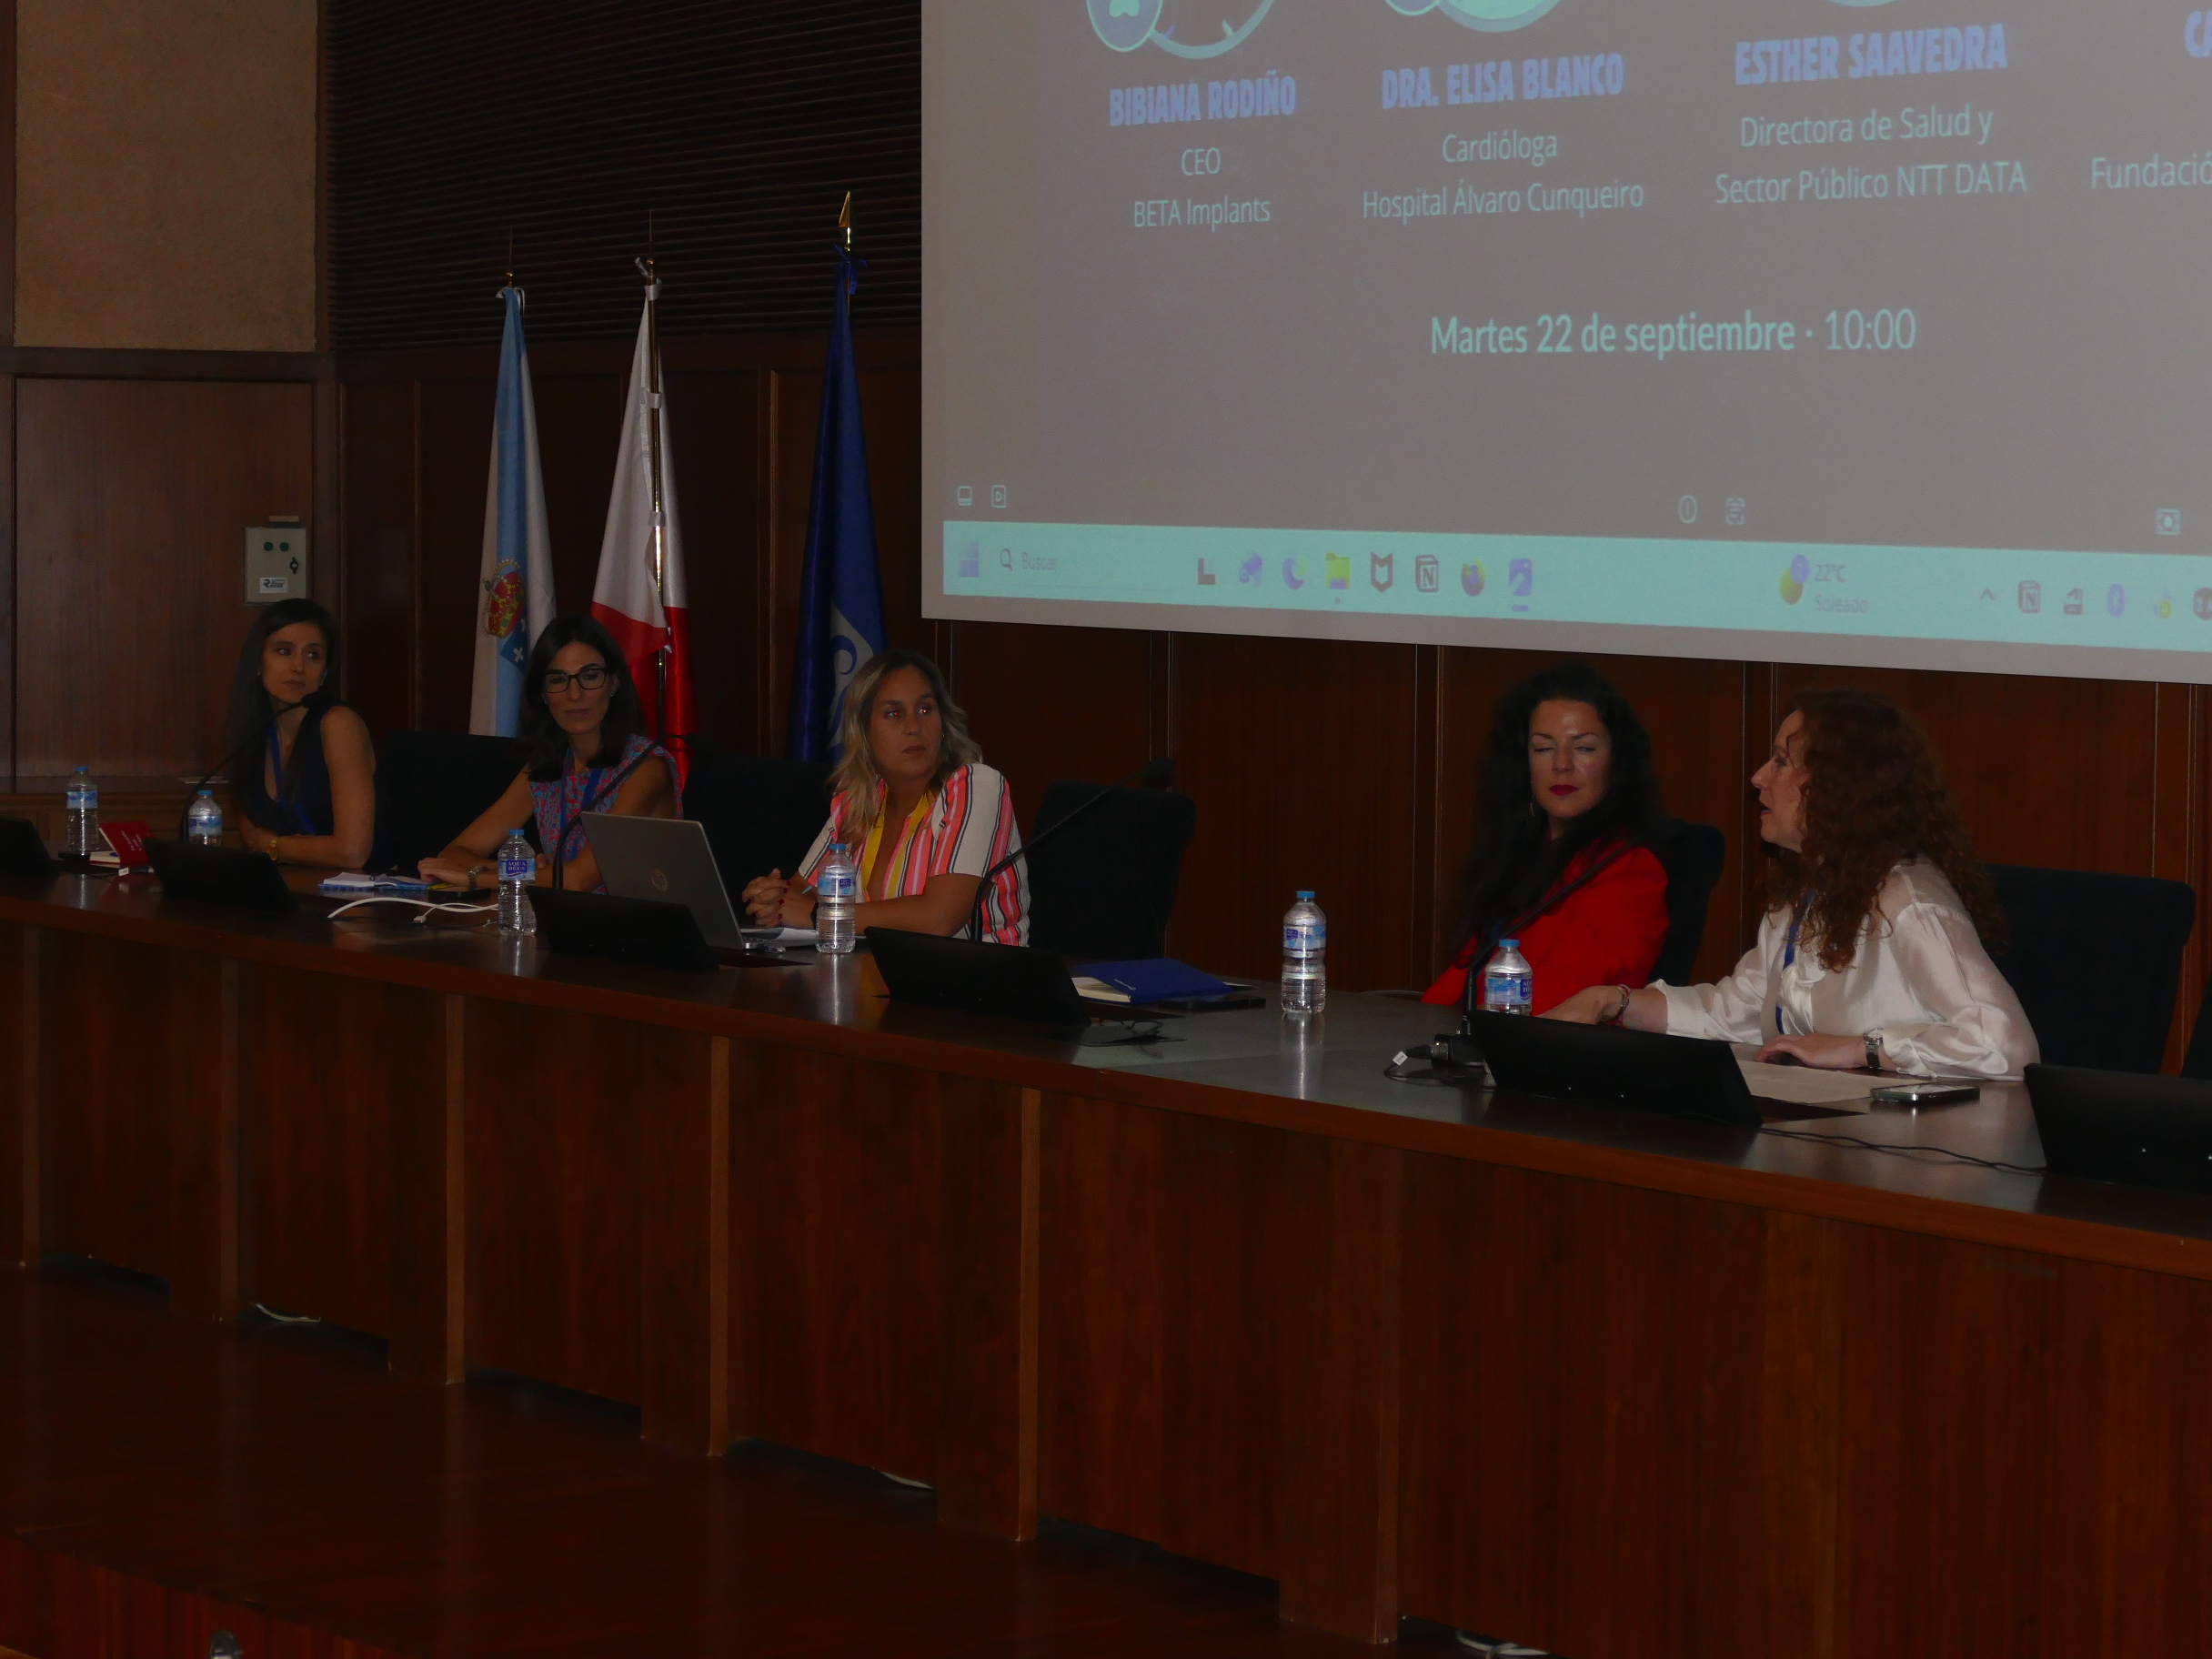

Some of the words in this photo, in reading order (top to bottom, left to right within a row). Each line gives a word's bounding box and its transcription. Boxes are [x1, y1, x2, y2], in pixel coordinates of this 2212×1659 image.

[1735, 35, 1840, 85] ESTHER
[1848, 23, 2007, 79] SAAVEDRA
[1110, 83, 1201, 126] BIBIANA
[1207, 69, 1296, 120] RODIÑO
[1382, 66, 1440, 109] DRA.
[1446, 60, 1514, 105] ELISA
[1522, 53, 1624, 100] BLANCO
[1443, 129, 1558, 166] Cardióloga
[1741, 115, 1854, 146] Directora
[1861, 109, 1893, 141] de
[1900, 103, 1971, 139] Salud
[1977, 112, 1994, 146] y
[1181, 147, 1221, 176] CEO
[1715, 173, 1791, 205] Sector
[1799, 165, 1889, 200] Público
[1897, 164, 1948, 196] NTT
[1956, 160, 2027, 195] DATA
[1134, 199, 1181, 227] BETA
[1187, 195, 1271, 232] Implants
[1363, 186, 1447, 226] Hospital
[1453, 178, 1521, 214] Álvaro
[1527, 179, 1644, 217] Cunqueiro
[1432, 317, 1528, 354] Martes
[1536, 314, 1573, 352] 22
[1581, 312, 1617, 353] de
[1624, 309, 1795, 361] septiembre
[1825, 307, 1916, 350] 10:00
